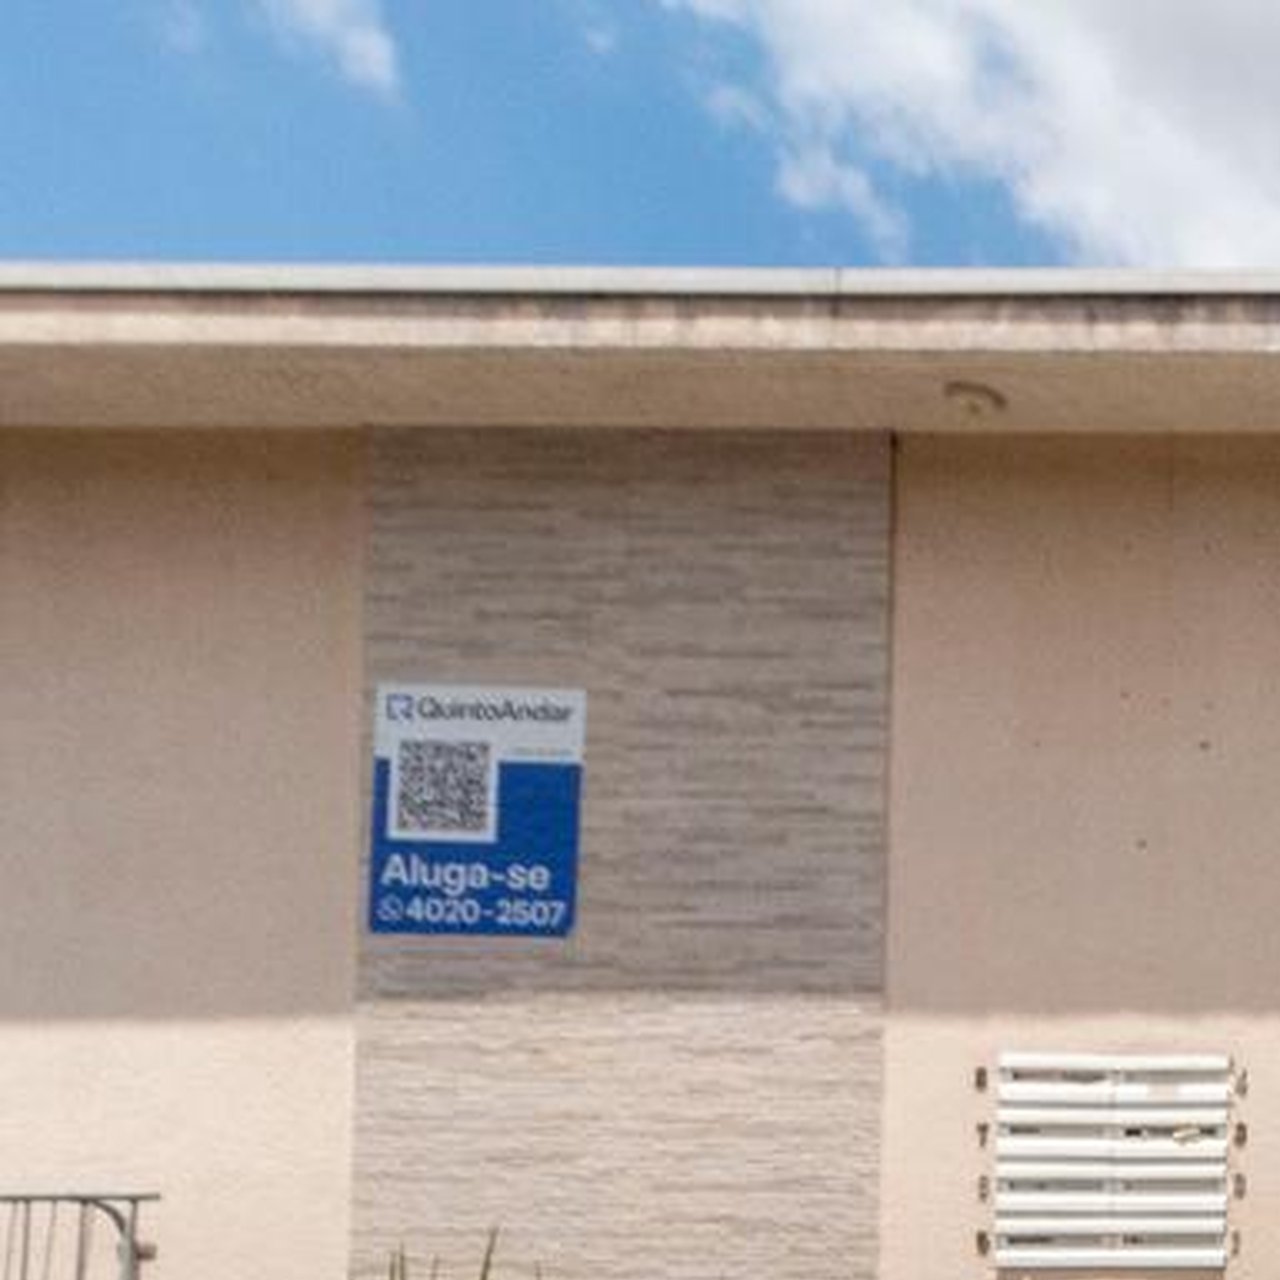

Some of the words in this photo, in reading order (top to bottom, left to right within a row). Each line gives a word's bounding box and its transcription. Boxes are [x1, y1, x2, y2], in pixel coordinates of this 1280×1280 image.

[417, 696, 574, 722] QuintoAndar
[380, 853, 551, 896] Aluga-se
[405, 896, 566, 926] 4020-2507
[976, 1122, 989, 1147] 7
